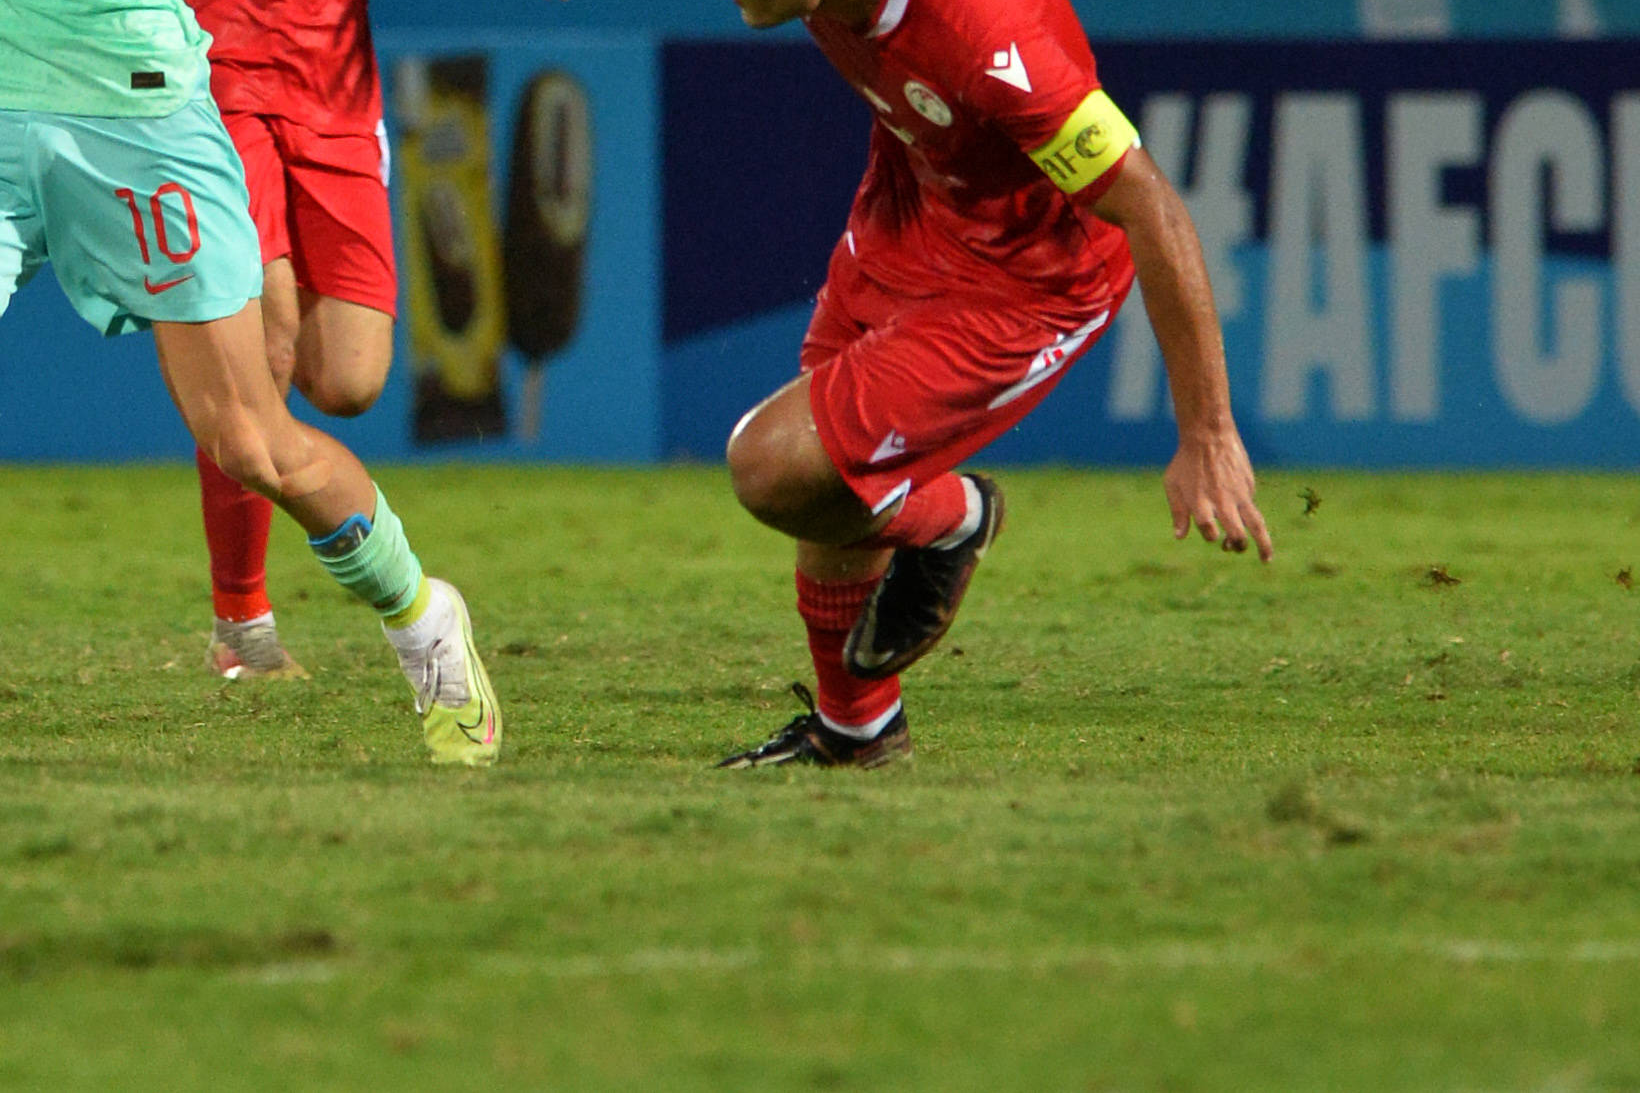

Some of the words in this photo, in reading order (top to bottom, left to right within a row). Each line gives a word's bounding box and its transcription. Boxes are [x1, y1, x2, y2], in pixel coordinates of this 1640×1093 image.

[1042, 123, 1111, 180] AFC
[115, 182, 201, 264] 10
[1105, 88, 1640, 426] #AFC
